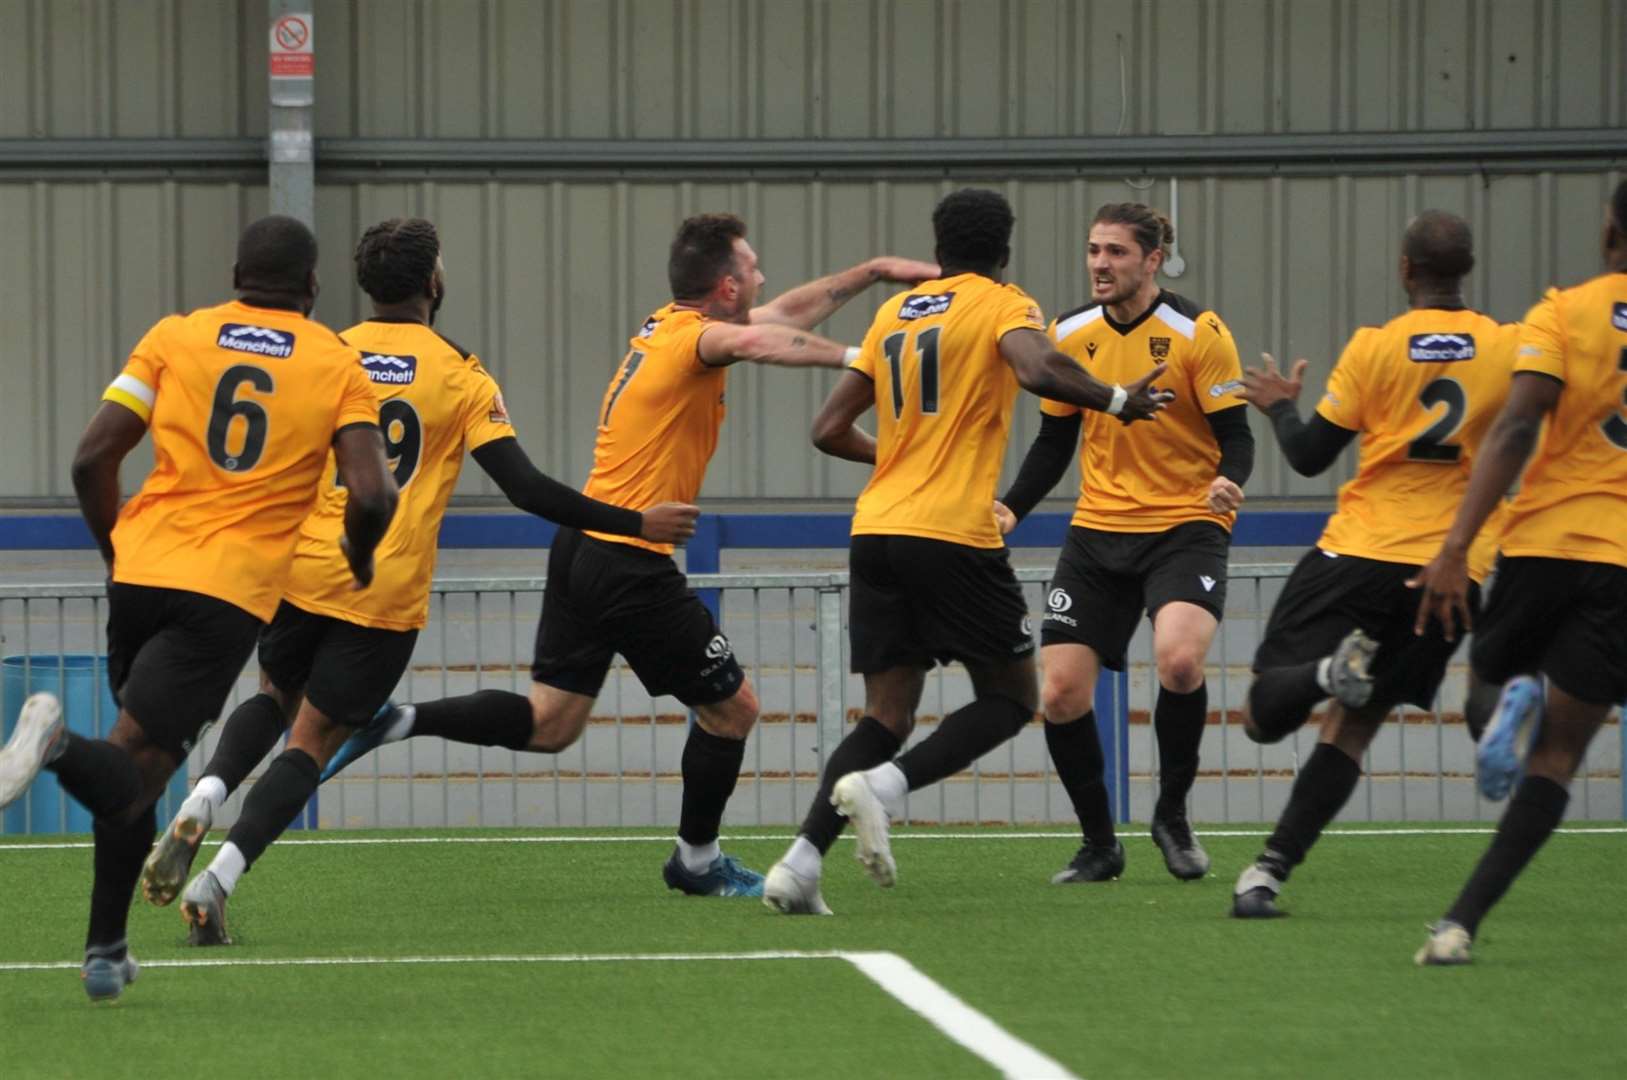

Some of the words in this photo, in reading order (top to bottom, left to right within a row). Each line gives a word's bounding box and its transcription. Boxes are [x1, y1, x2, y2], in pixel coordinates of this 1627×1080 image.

[218, 334, 292, 357] Manchett
[366, 370, 414, 383] nchett
[883, 325, 943, 420] 11
[207, 364, 274, 473] 6
[1408, 378, 1466, 461] 2
